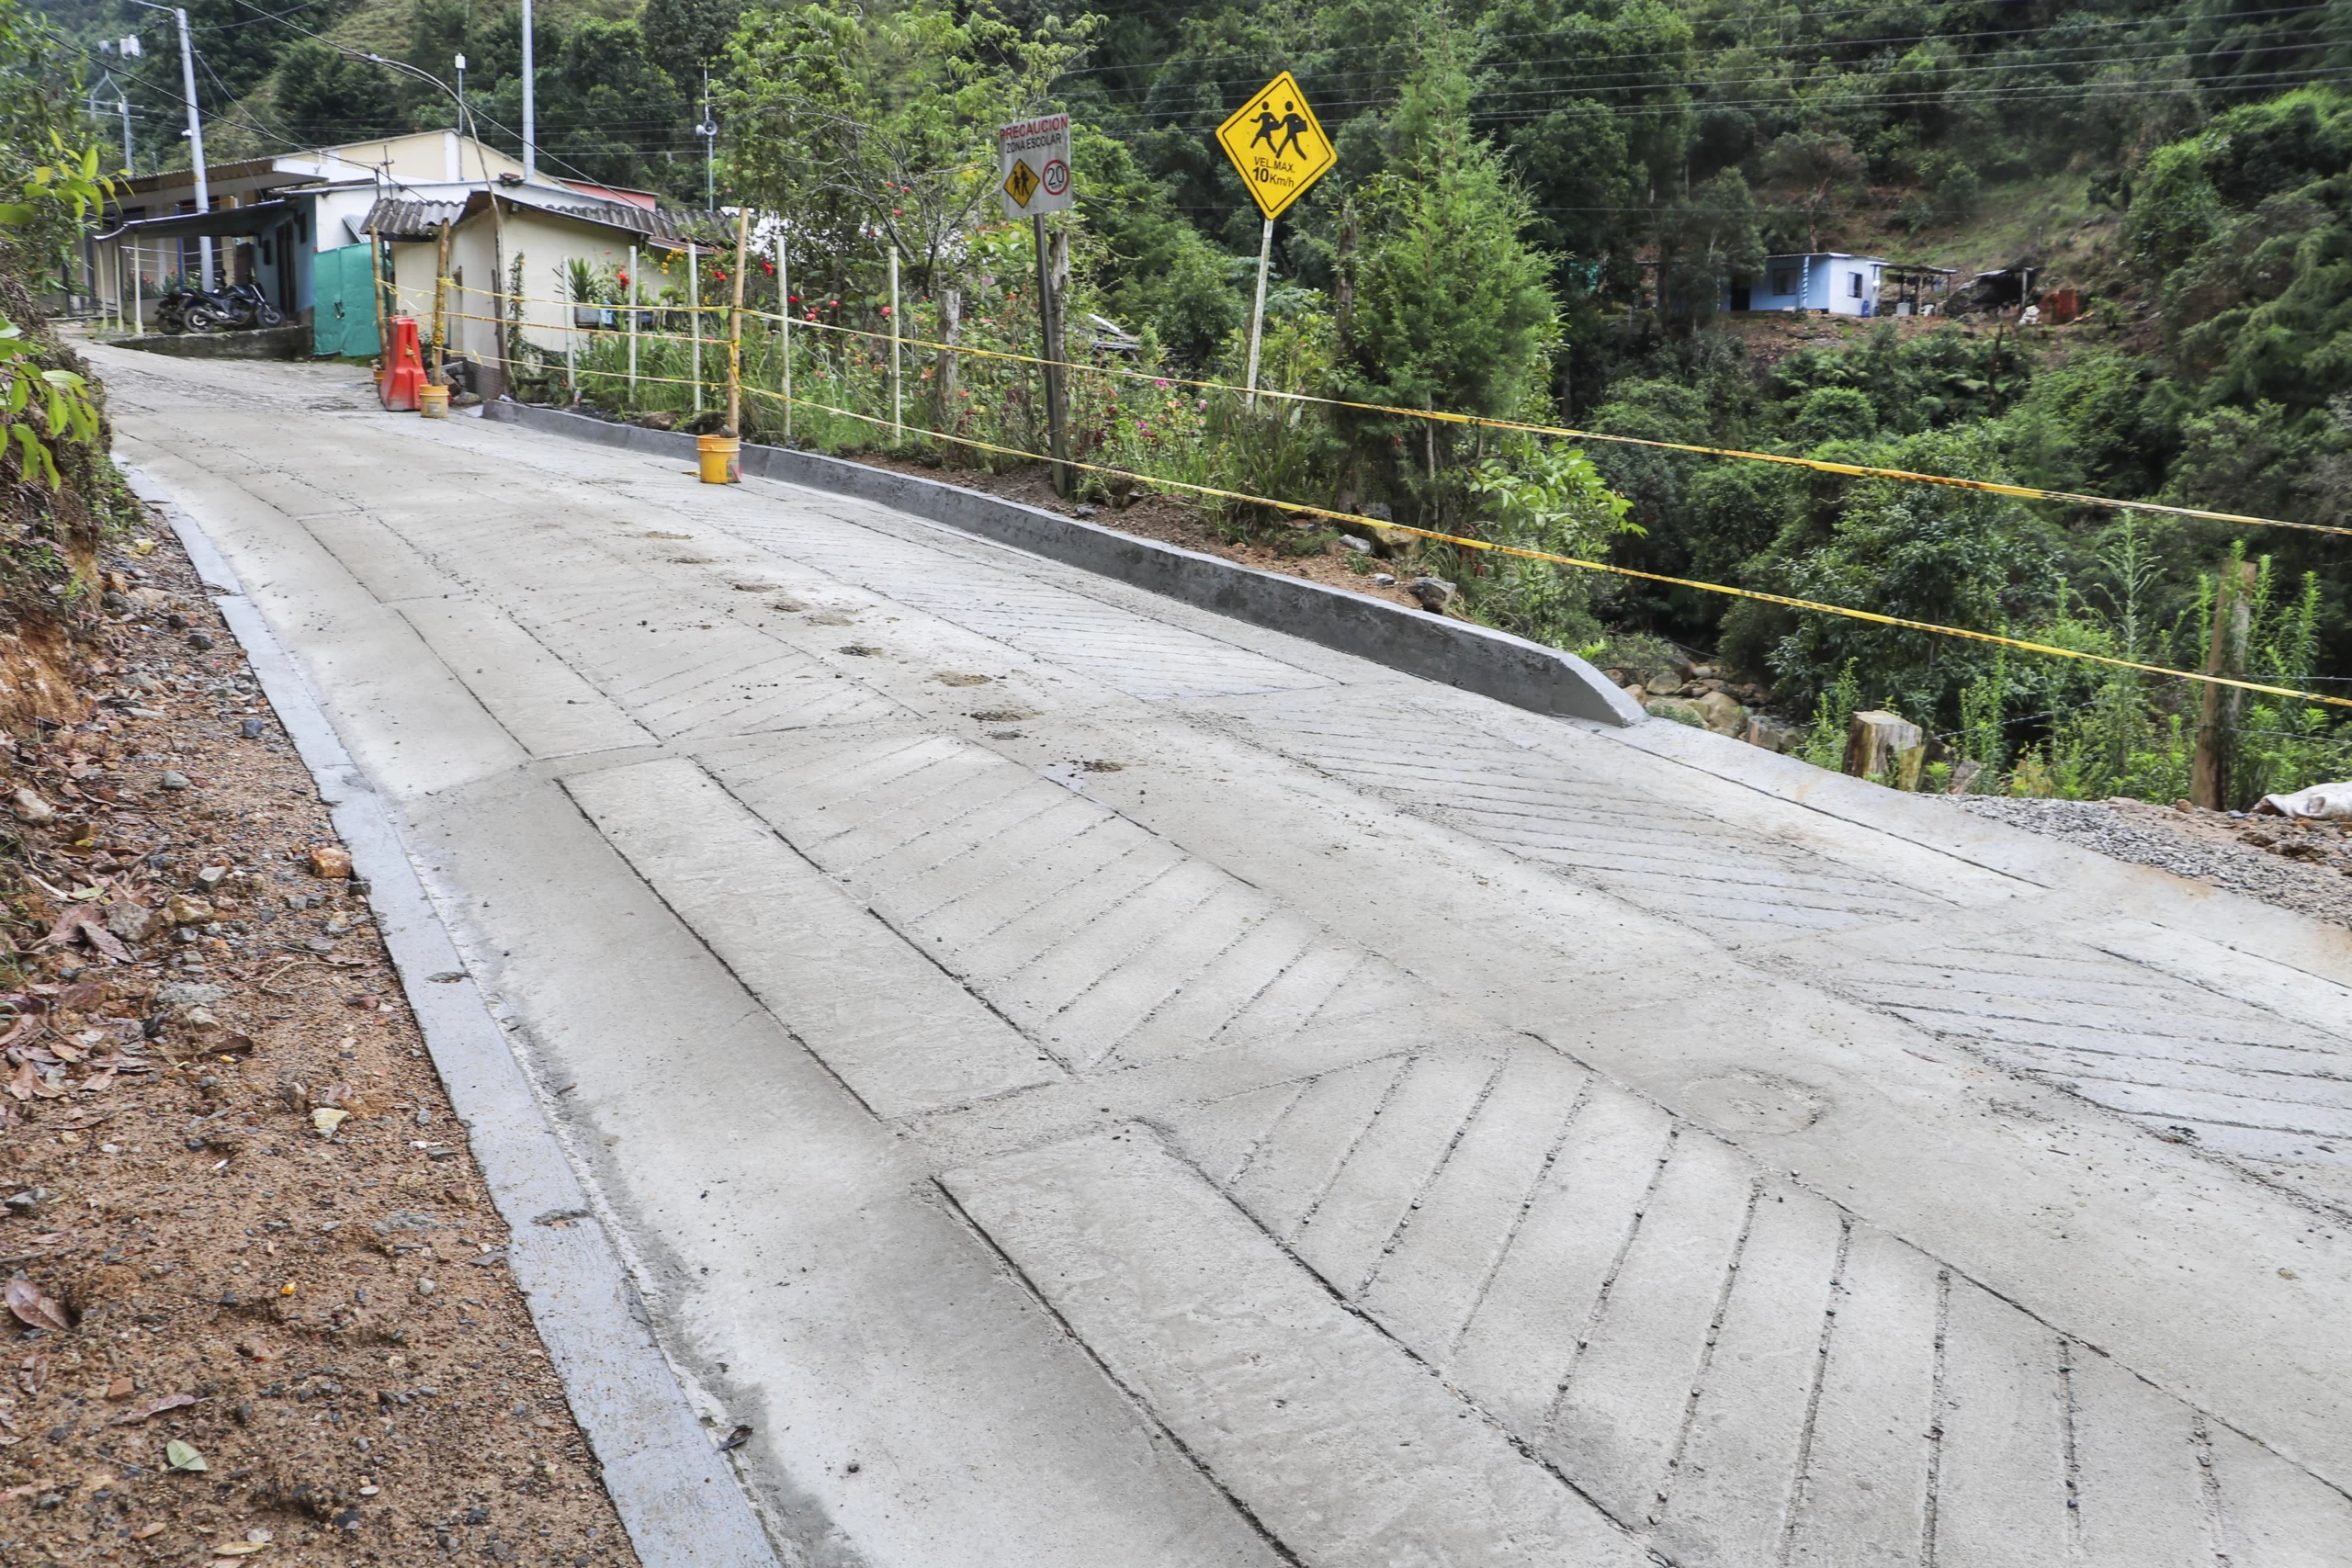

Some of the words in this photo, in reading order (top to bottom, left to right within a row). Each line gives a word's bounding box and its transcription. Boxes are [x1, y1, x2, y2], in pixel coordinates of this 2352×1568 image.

[1000, 116, 1069, 140] PRECAUCION
[1006, 141, 1025, 153] ZONA
[1026, 133, 1061, 150] ESCOLAR
[1046, 165, 1065, 186] 20
